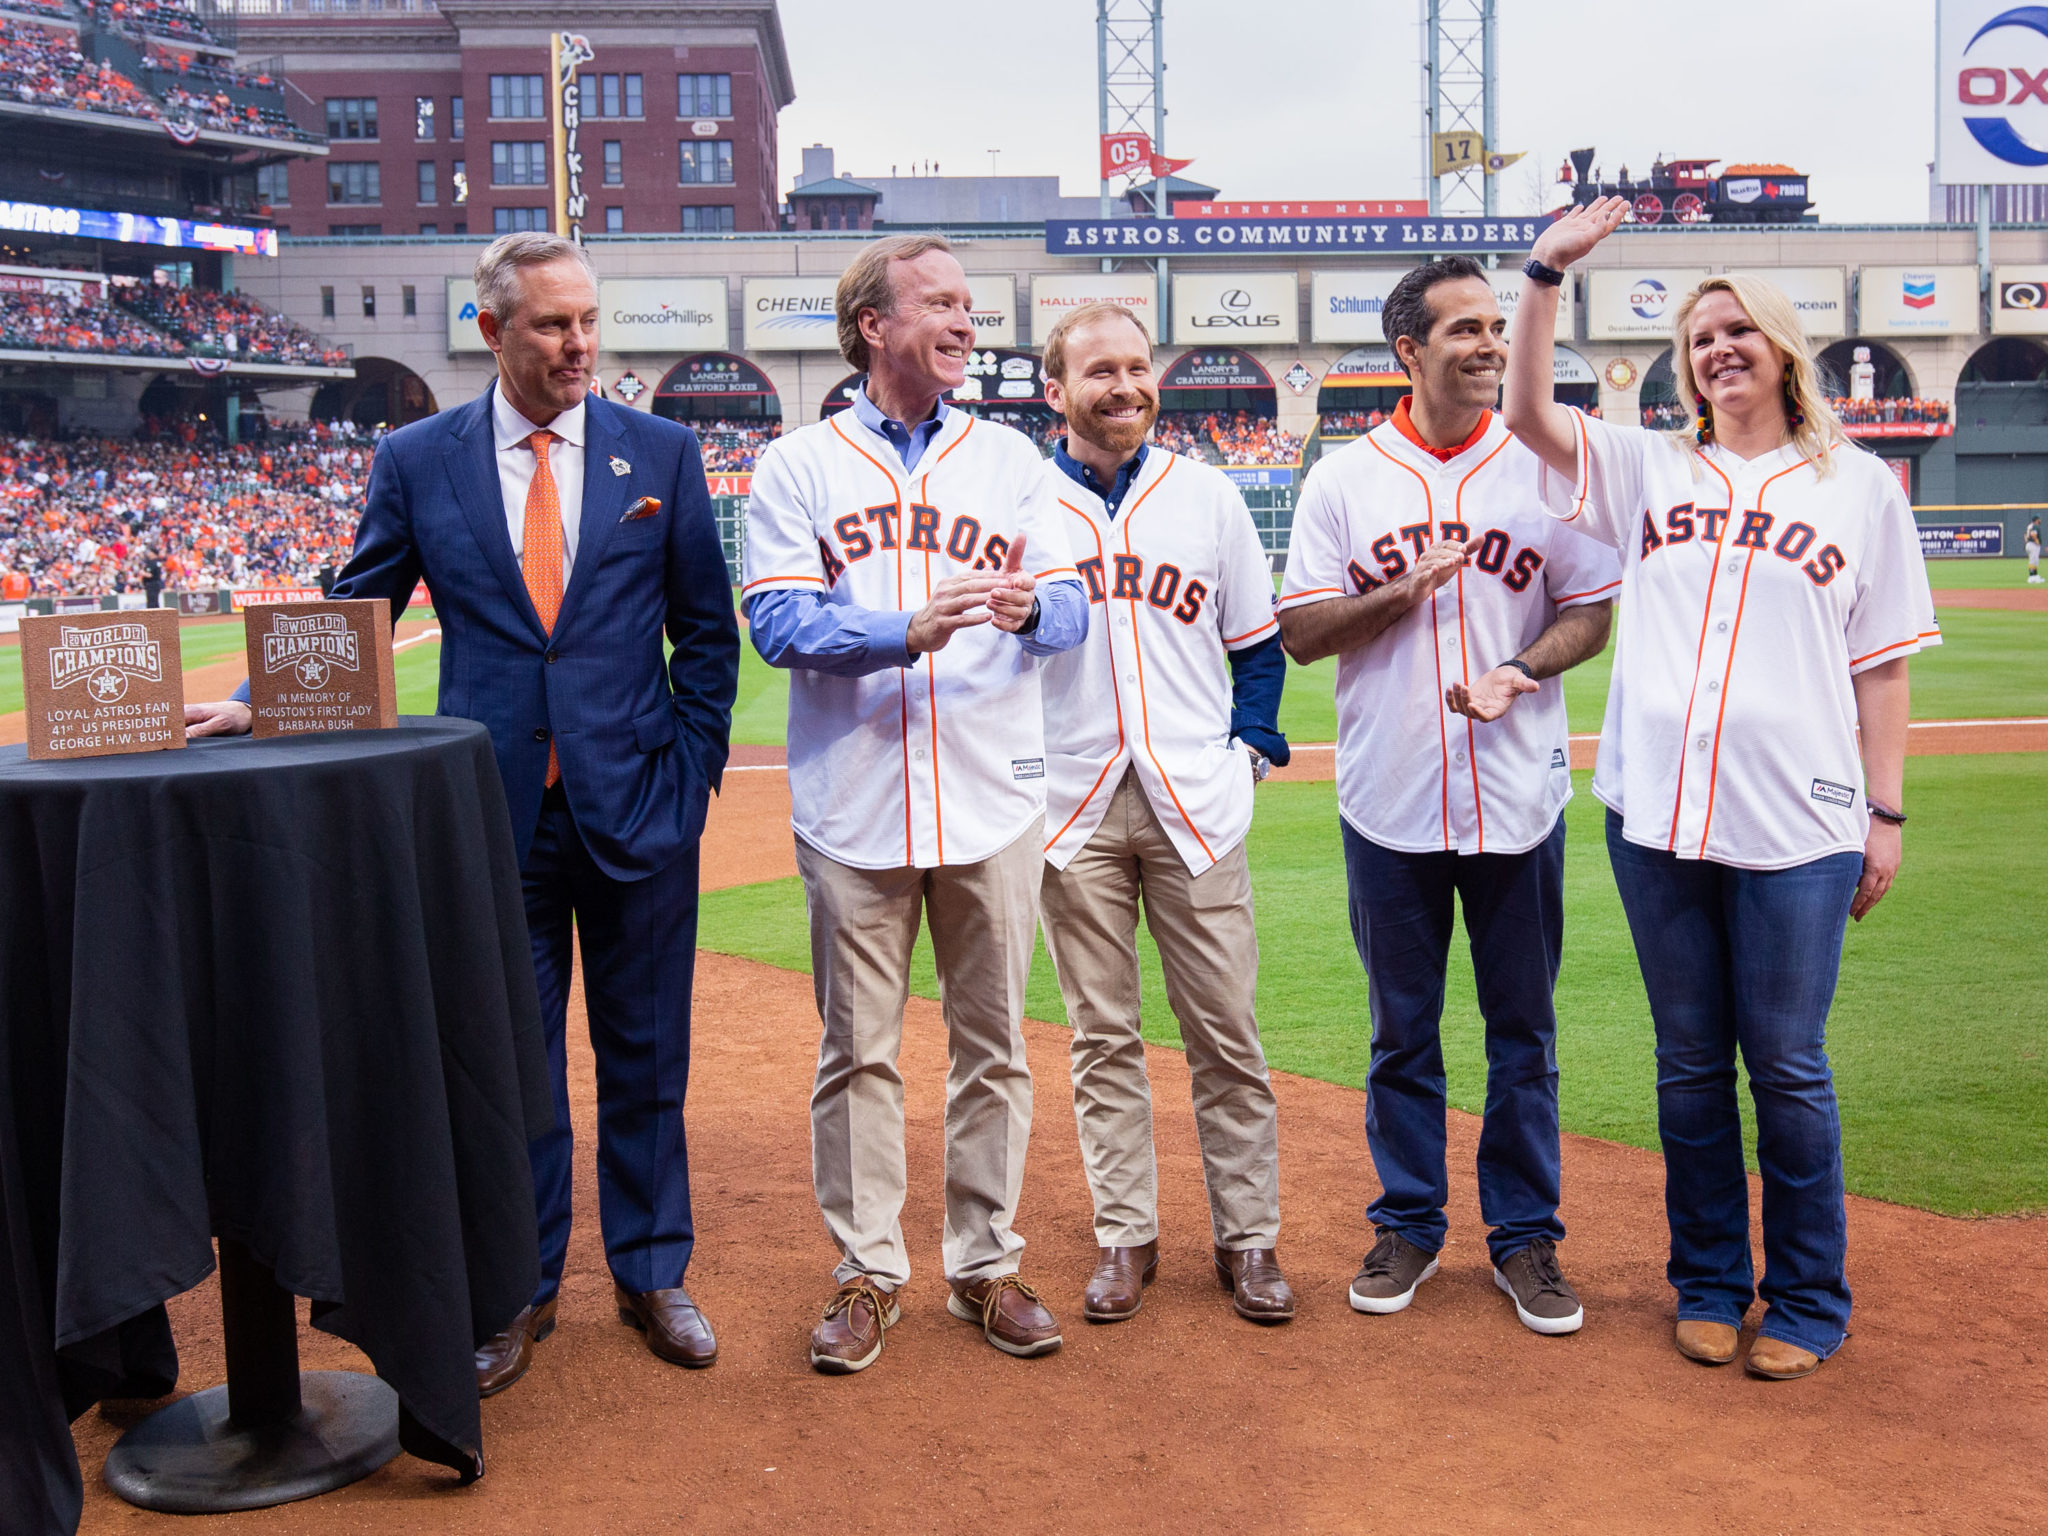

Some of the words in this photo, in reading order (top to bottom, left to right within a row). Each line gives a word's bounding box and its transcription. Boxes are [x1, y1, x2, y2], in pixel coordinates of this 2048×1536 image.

[564, 85, 585, 217] CHIKIN
[1110, 140, 1140, 165] 05
[1445, 139, 1470, 162] 17
[1779, 184, 1805, 196] PROUD
[1201, 205, 1309, 215] MINUTE
[1195, 225, 1388, 244] COMMUNITY
[1402, 223, 1535, 243] LEADERS
[757, 297, 838, 312] CHENIE
[1330, 296, 1384, 315] Schlumb
[1631, 294, 1668, 304] OXY
[613, 310, 713, 326] ConocoPhillips
[1191, 315, 1280, 328] LEXUS
[1191, 365, 1240, 375] LANDRY'S
[1337, 361, 1390, 373] Crawford
[690, 372, 739, 381] LANDRY'S
[1175, 376, 1226, 385] CRAWFORD
[1229, 376, 1257, 385] BOXES
[673, 384, 726, 392] CRAWFORD
[729, 383, 757, 391] BOXES
[1917, 530, 1954, 539] USTON
[1971, 530, 1999, 538] OPEN
[1640, 501, 1847, 587] ASTROS
[1076, 553, 1208, 625] TROS
[233, 592, 282, 606] WELLS
[286, 590, 324, 602] FARG
[288, 616, 333, 634] WORLD
[80, 626, 132, 647] WORLD
[267, 636, 356, 663] CHAMPIONS
[54, 645, 157, 678] CHAMPIONS
[277, 693, 287, 704] IN
[291, 693, 334, 703] MEMORY
[338, 692, 351, 702] OF
[48, 709, 90, 722] LOYAL
[94, 704, 142, 718] ASTROS
[146, 701, 170, 713] FAN
[259, 706, 314, 718] HOUSTON'S
[317, 706, 343, 716] FIRST
[345, 705, 372, 716] LADY
[52, 724, 74, 736] 41st
[82, 723, 98, 734] US
[102, 716, 168, 732] PRESIDENT
[278, 720, 324, 731] BARBARA
[328, 719, 354, 730] BUSH
[50, 736, 101, 750] GEORGE
[106, 734, 135, 745] H.W.
[140, 730, 172, 742] BUSH
